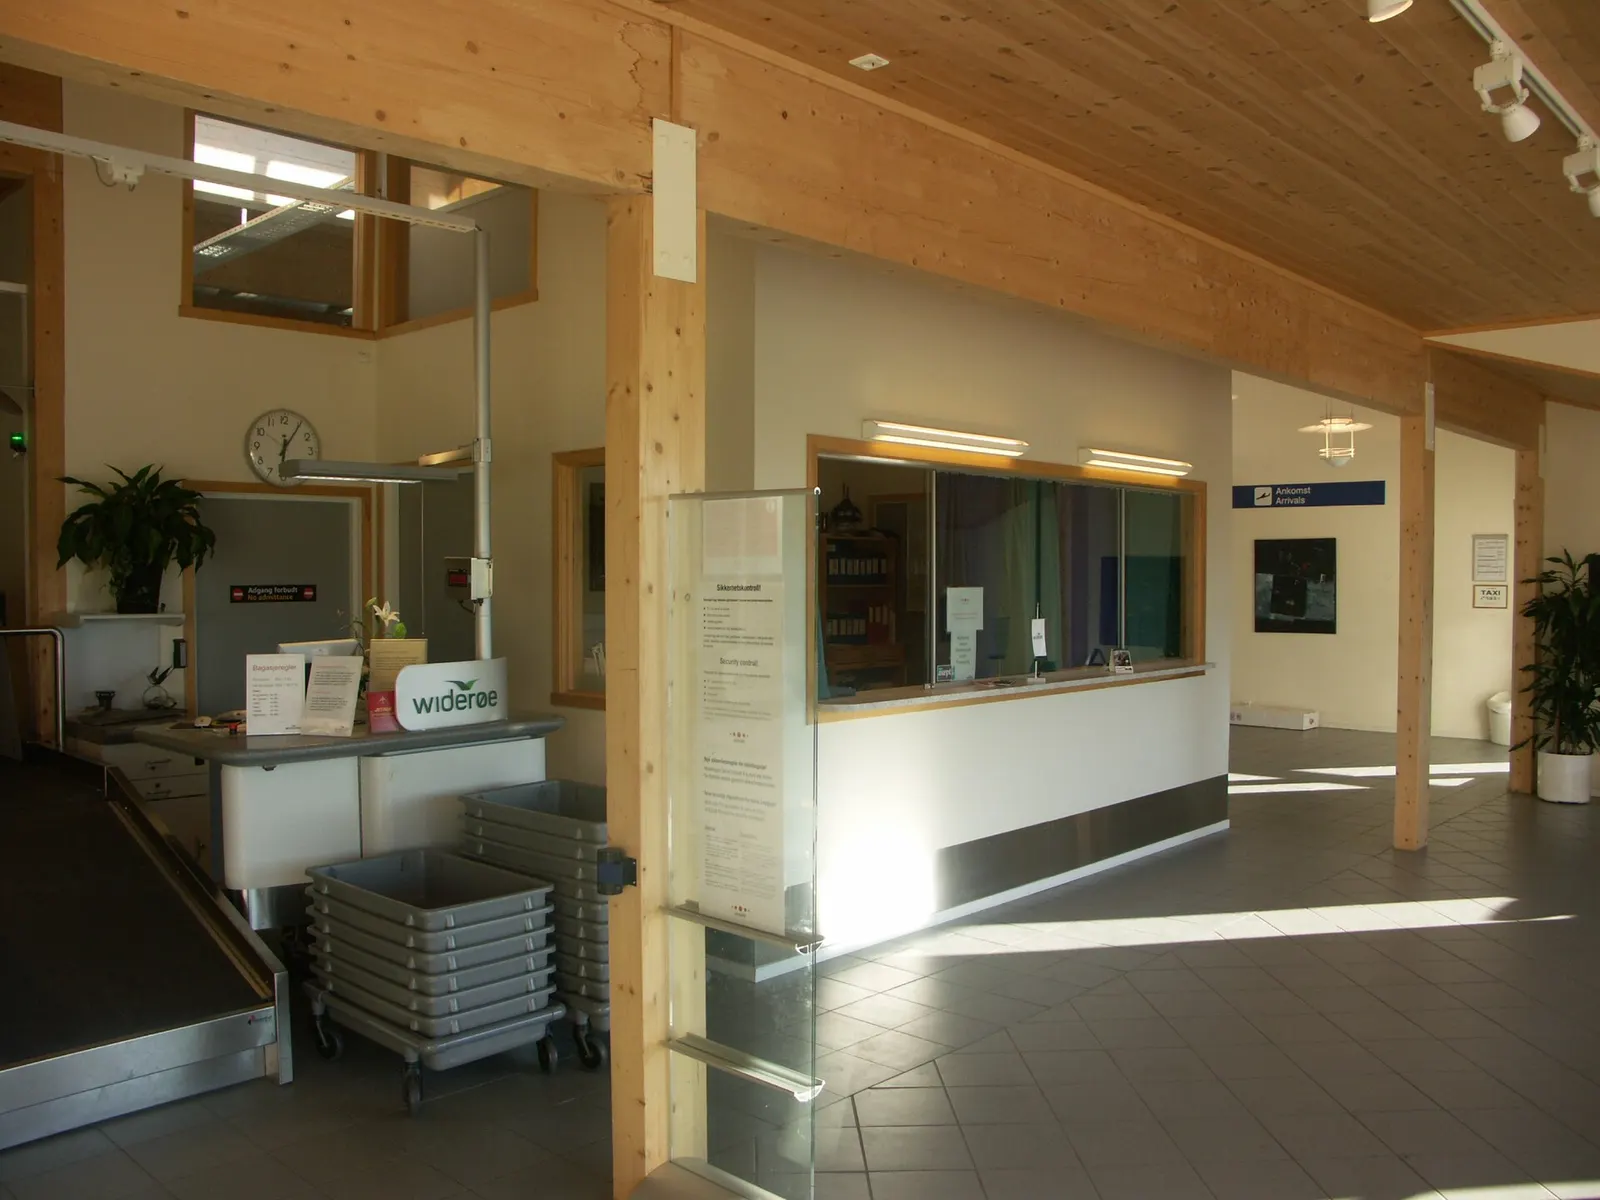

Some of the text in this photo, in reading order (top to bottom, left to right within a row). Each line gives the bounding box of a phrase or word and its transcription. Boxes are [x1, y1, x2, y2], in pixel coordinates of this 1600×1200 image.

[267, 416, 275, 427] 11
[280, 415, 288, 425] 12
[256, 427, 265, 437] 10
[303, 432, 311, 442] 2
[253, 441, 260, 450] 9
[307, 446, 314, 456] 3
[267, 467, 273, 478] 7
[1275, 486, 1311, 495] Ankomst
[1275, 497, 1306, 505] Arrivals
[247, 586, 298, 595] Adgang forbudt
[412, 689, 498, 714] widerøe
